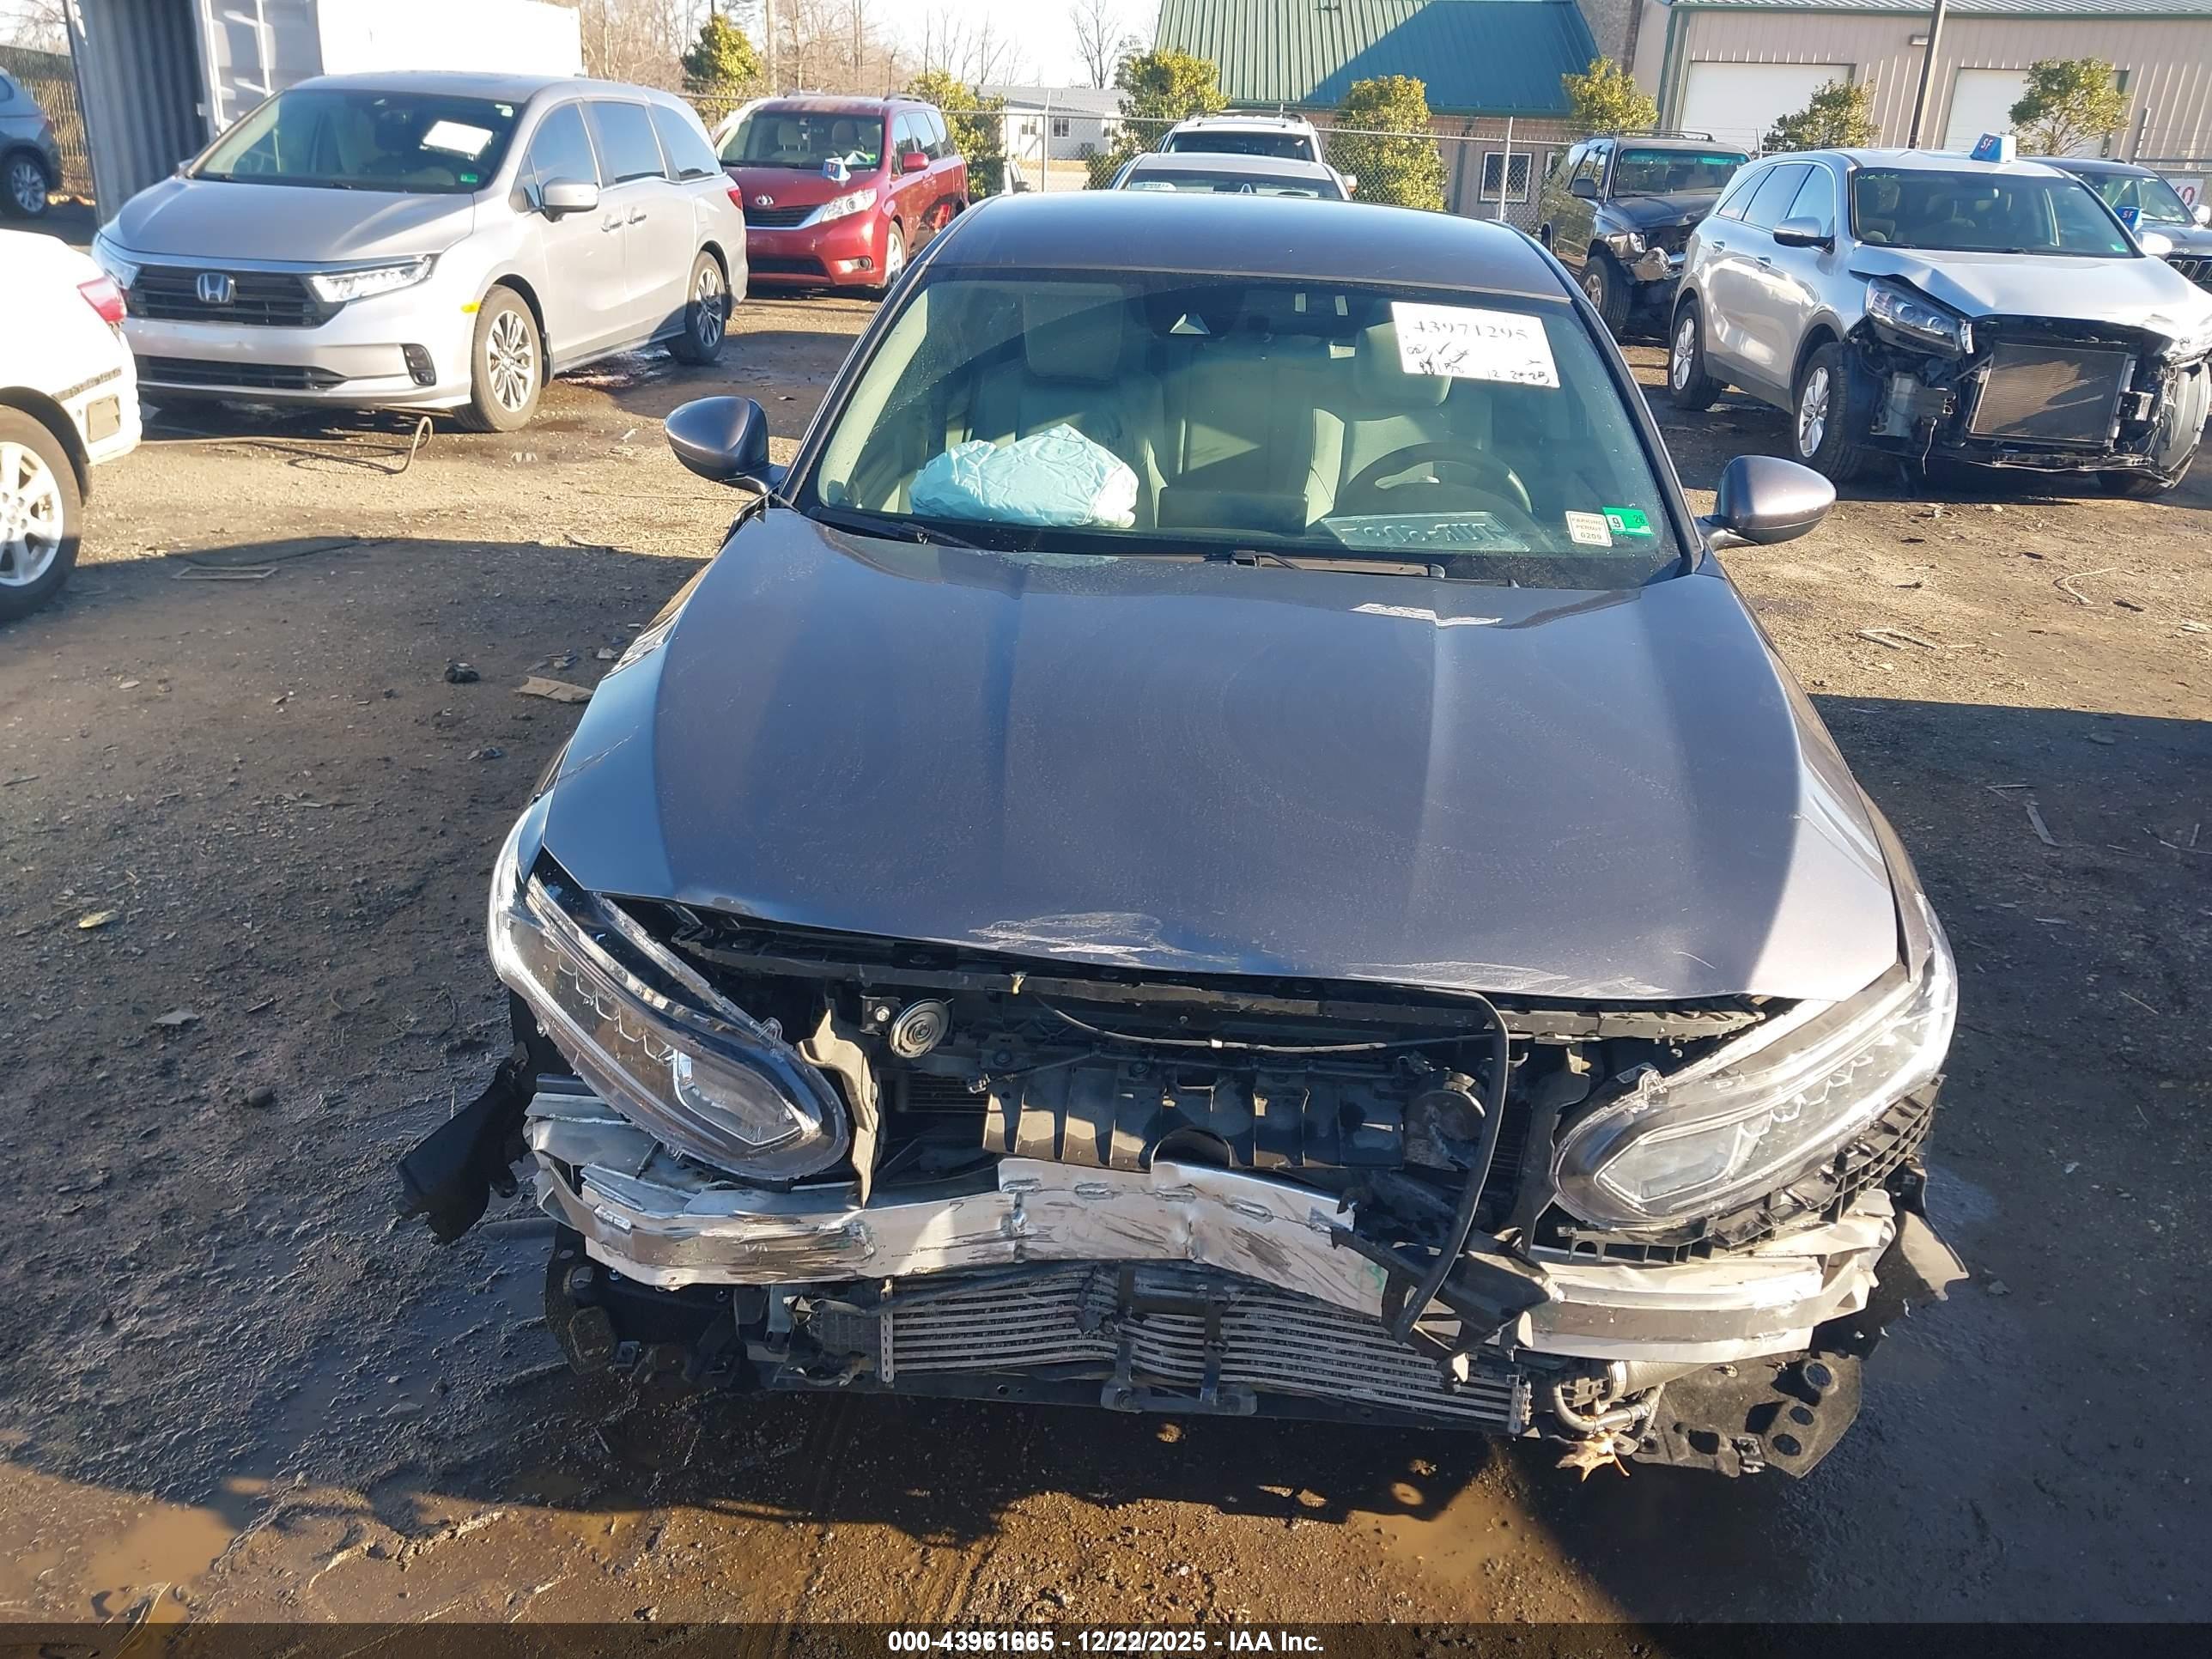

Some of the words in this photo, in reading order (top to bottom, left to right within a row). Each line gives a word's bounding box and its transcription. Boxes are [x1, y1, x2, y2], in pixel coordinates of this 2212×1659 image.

[1981, 137, 1993, 151] SF
[2122, 210, 2134, 219] SF
[1632, 514, 1645, 524] 26
